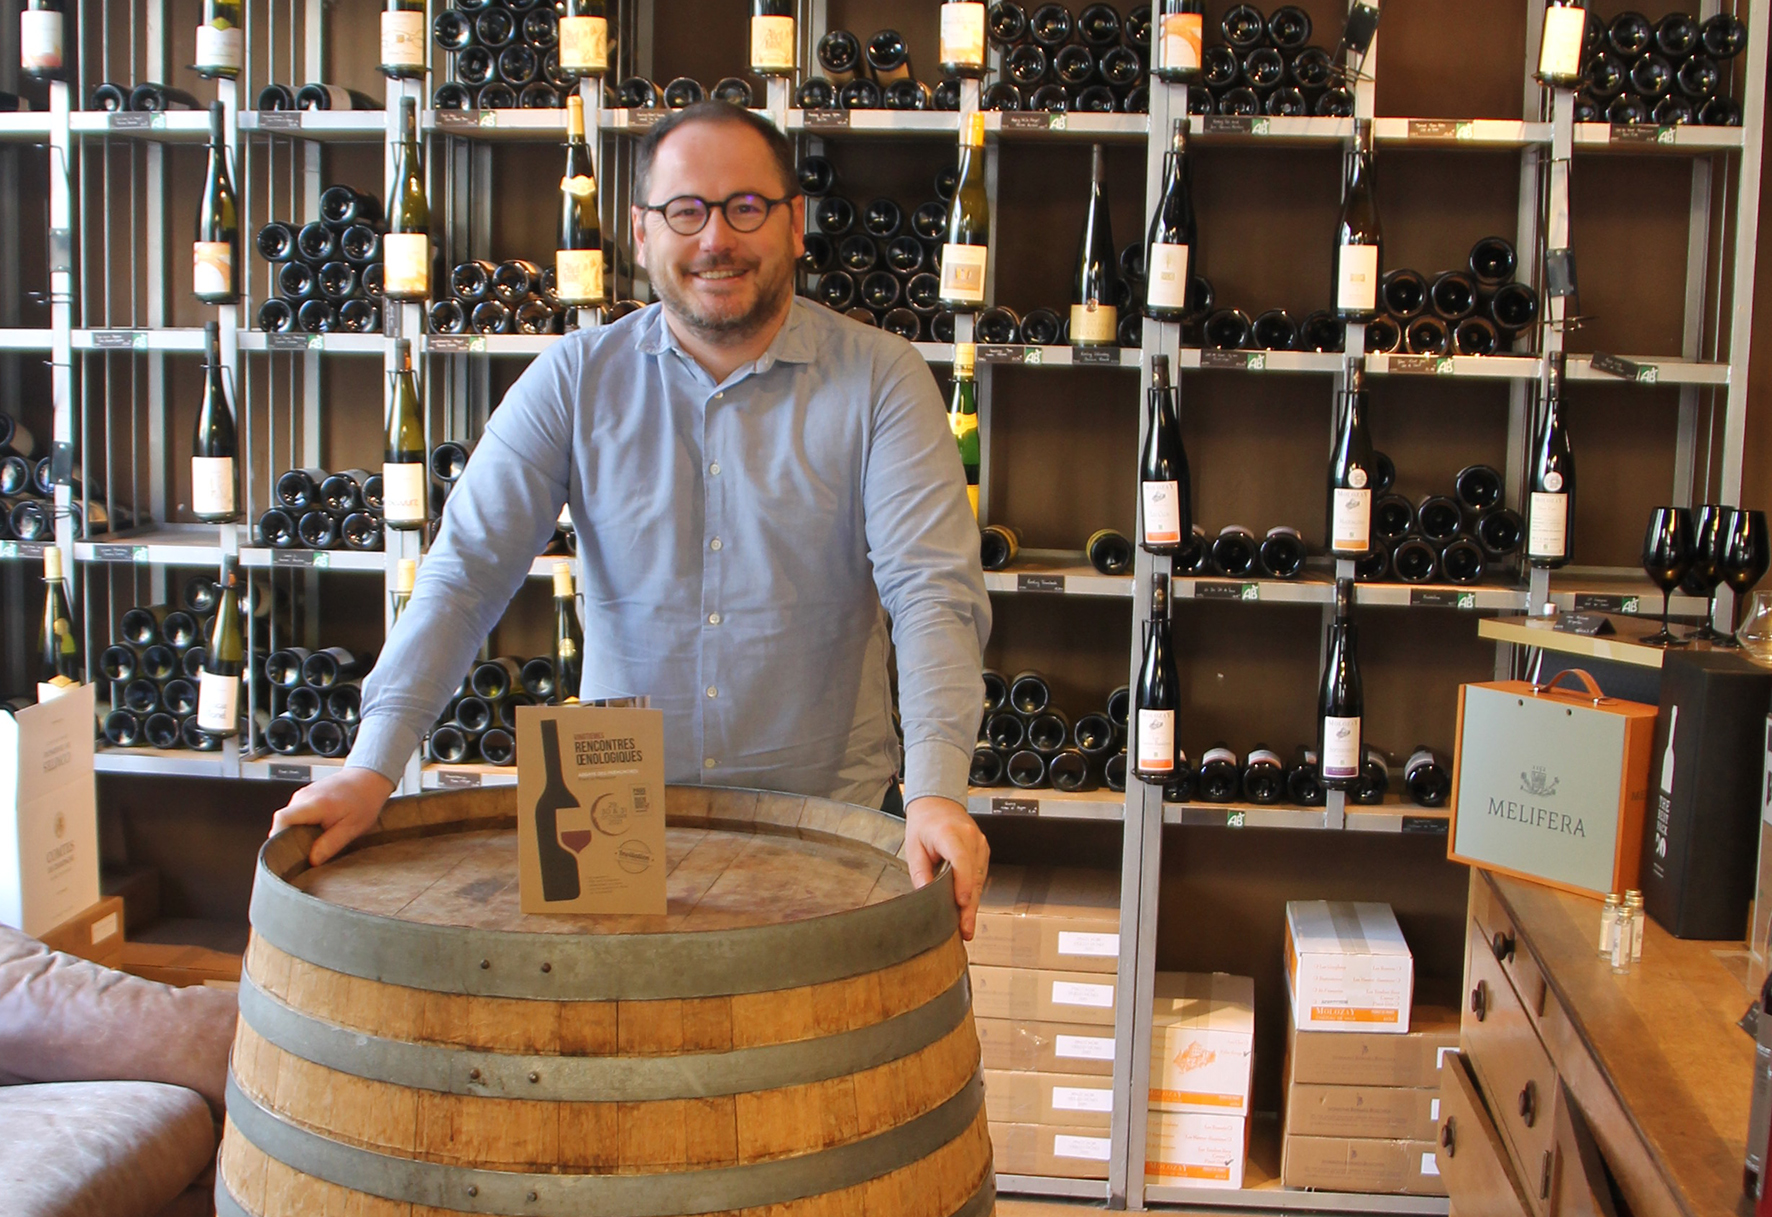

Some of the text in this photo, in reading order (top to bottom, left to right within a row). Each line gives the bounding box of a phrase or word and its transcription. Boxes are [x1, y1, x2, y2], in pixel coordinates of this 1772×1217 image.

[1049, 114, 1066, 130] AB
[1251, 119, 1269, 135] AB
[1657, 126, 1676, 142] AB
[1024, 348, 1042, 364] AB
[1247, 353, 1265, 370] AB
[1436, 357, 1454, 374] AB
[1640, 366, 1658, 383] AB
[1242, 584, 1259, 600] AB
[1458, 593, 1475, 609] AB
[1621, 597, 1639, 613] AB
[574, 738, 635, 753] RENCONTRES
[576, 750, 643, 766] ŒNOLOGIQUES
[1228, 812, 1245, 827] AB
[1487, 797, 1587, 838] MELIFERA
[1316, 1007, 1355, 1016] MOLOZAY
